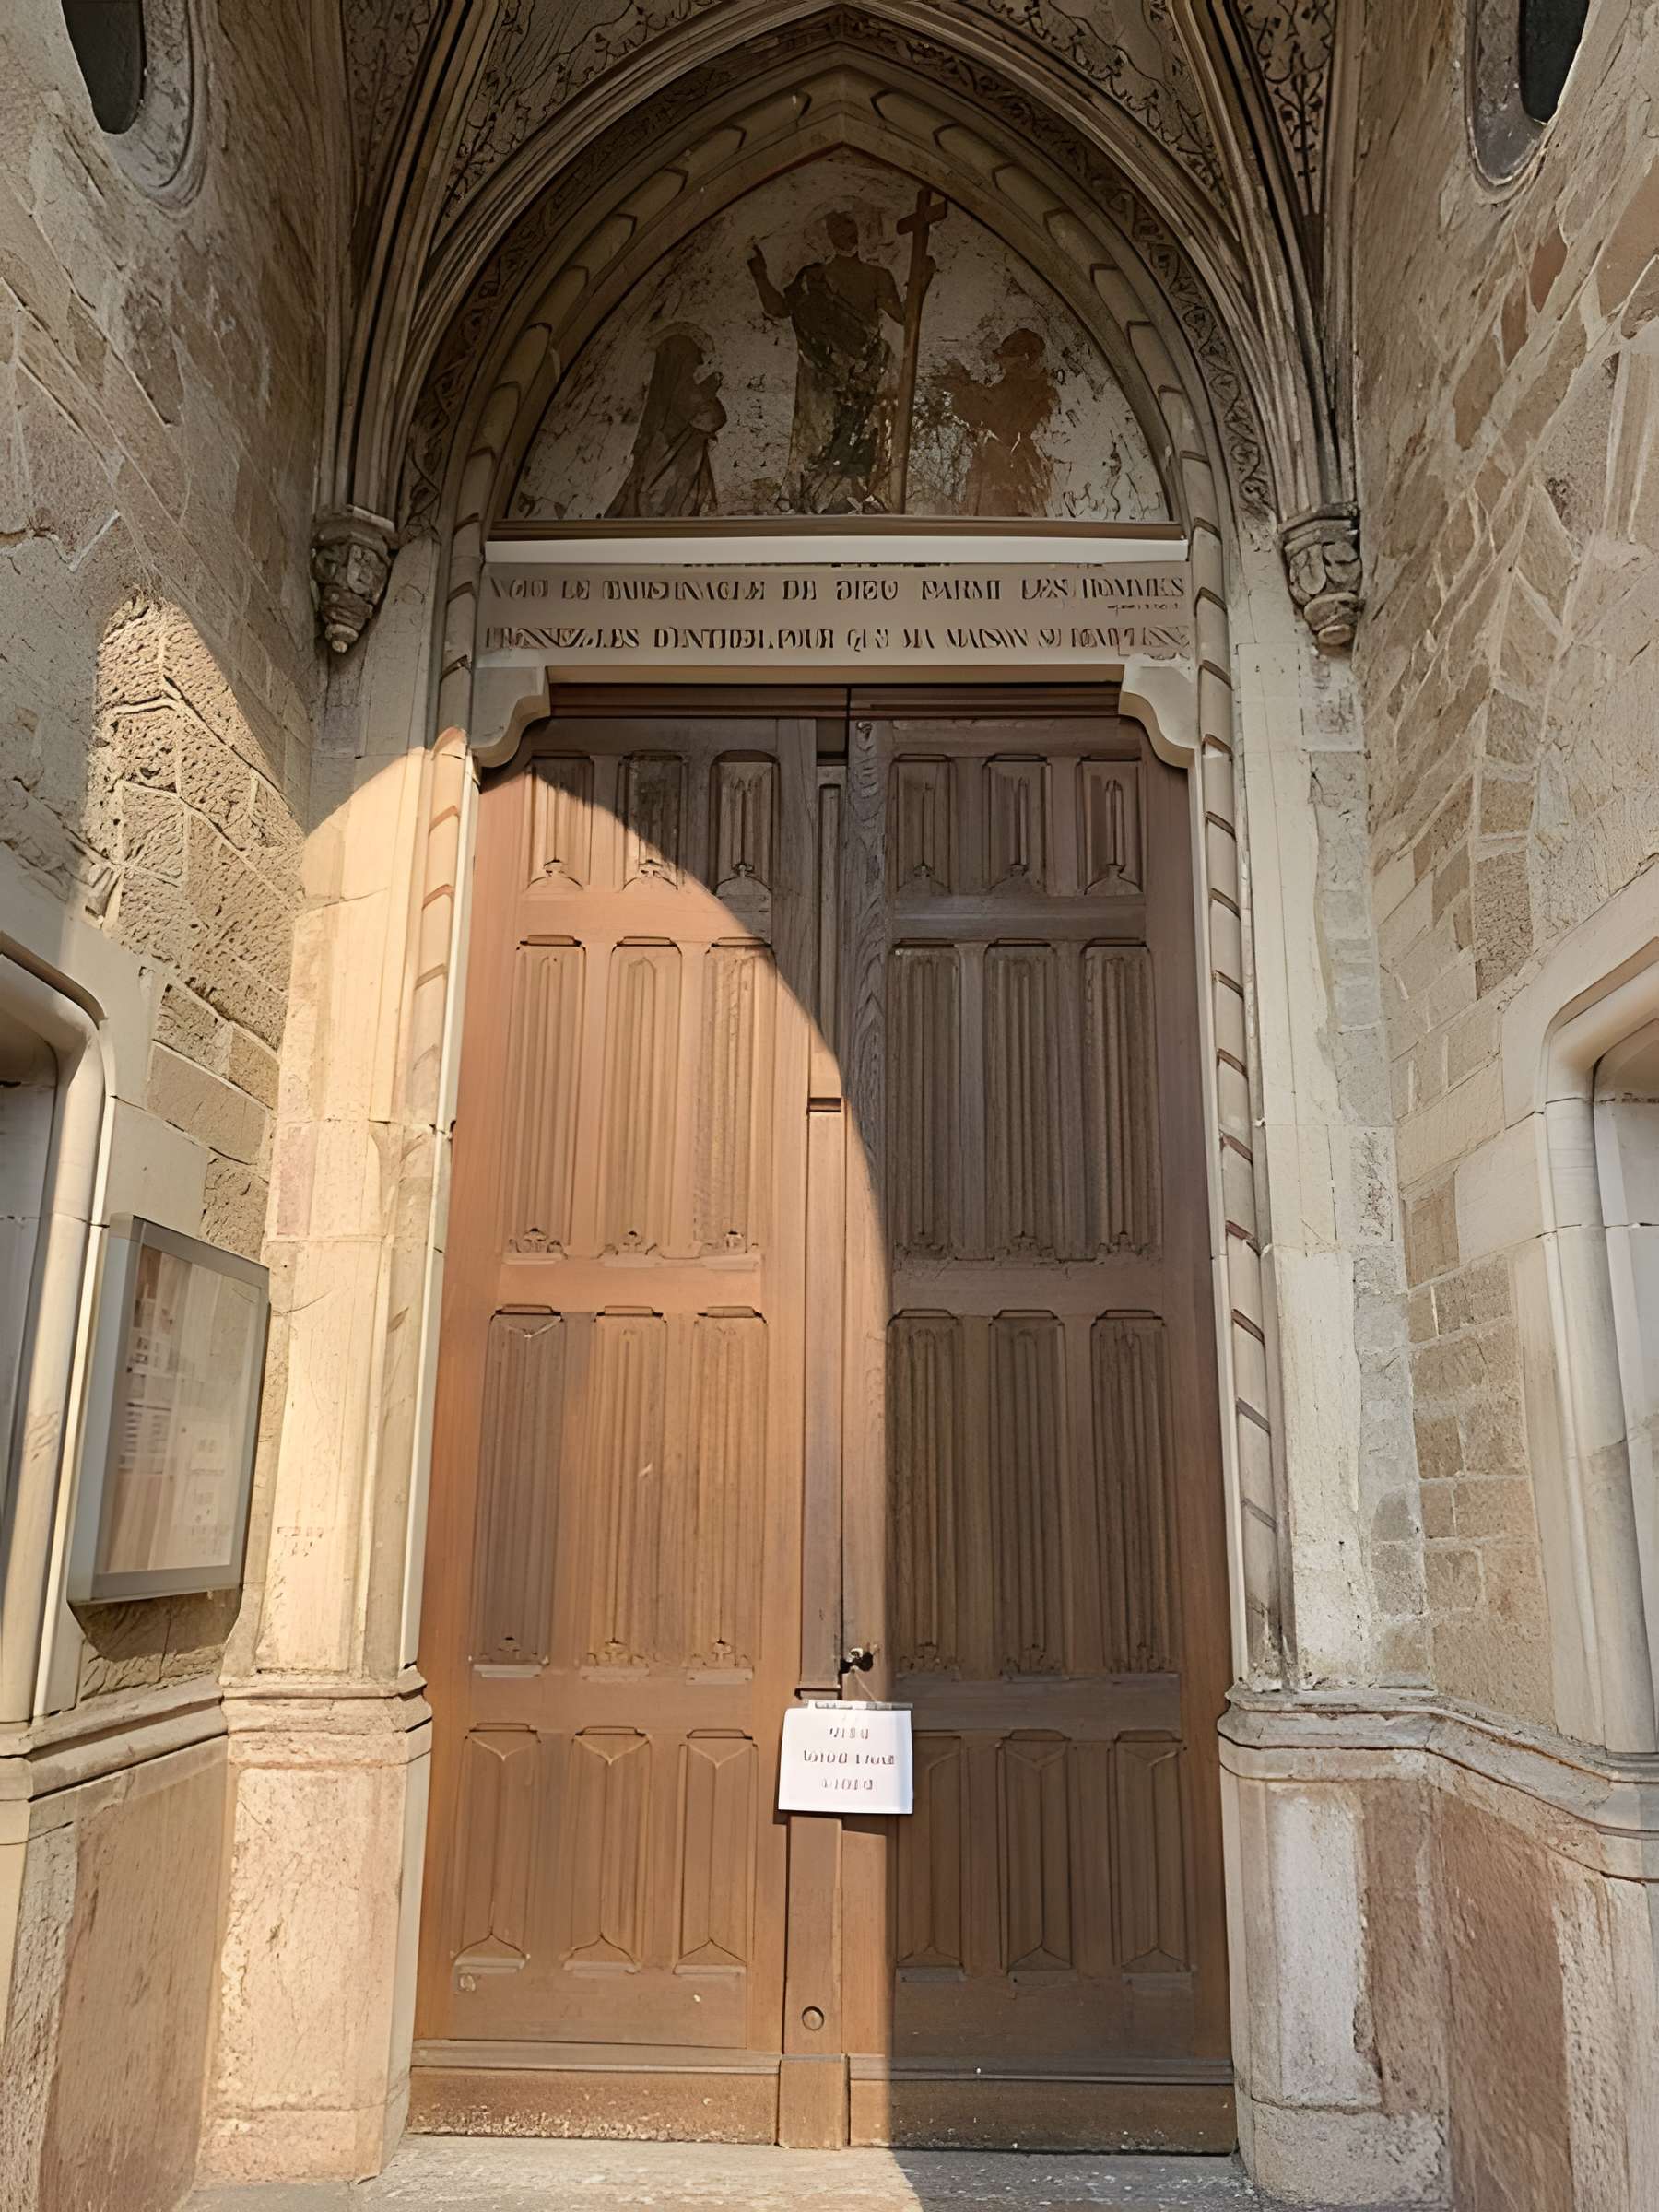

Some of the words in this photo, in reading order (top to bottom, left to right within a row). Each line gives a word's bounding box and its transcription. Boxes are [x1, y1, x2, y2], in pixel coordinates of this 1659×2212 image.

[835, 580, 899, 600] DIEU
[921, 580, 1002, 600] PARMI
[1082, 577, 1185, 599] HOMMES
